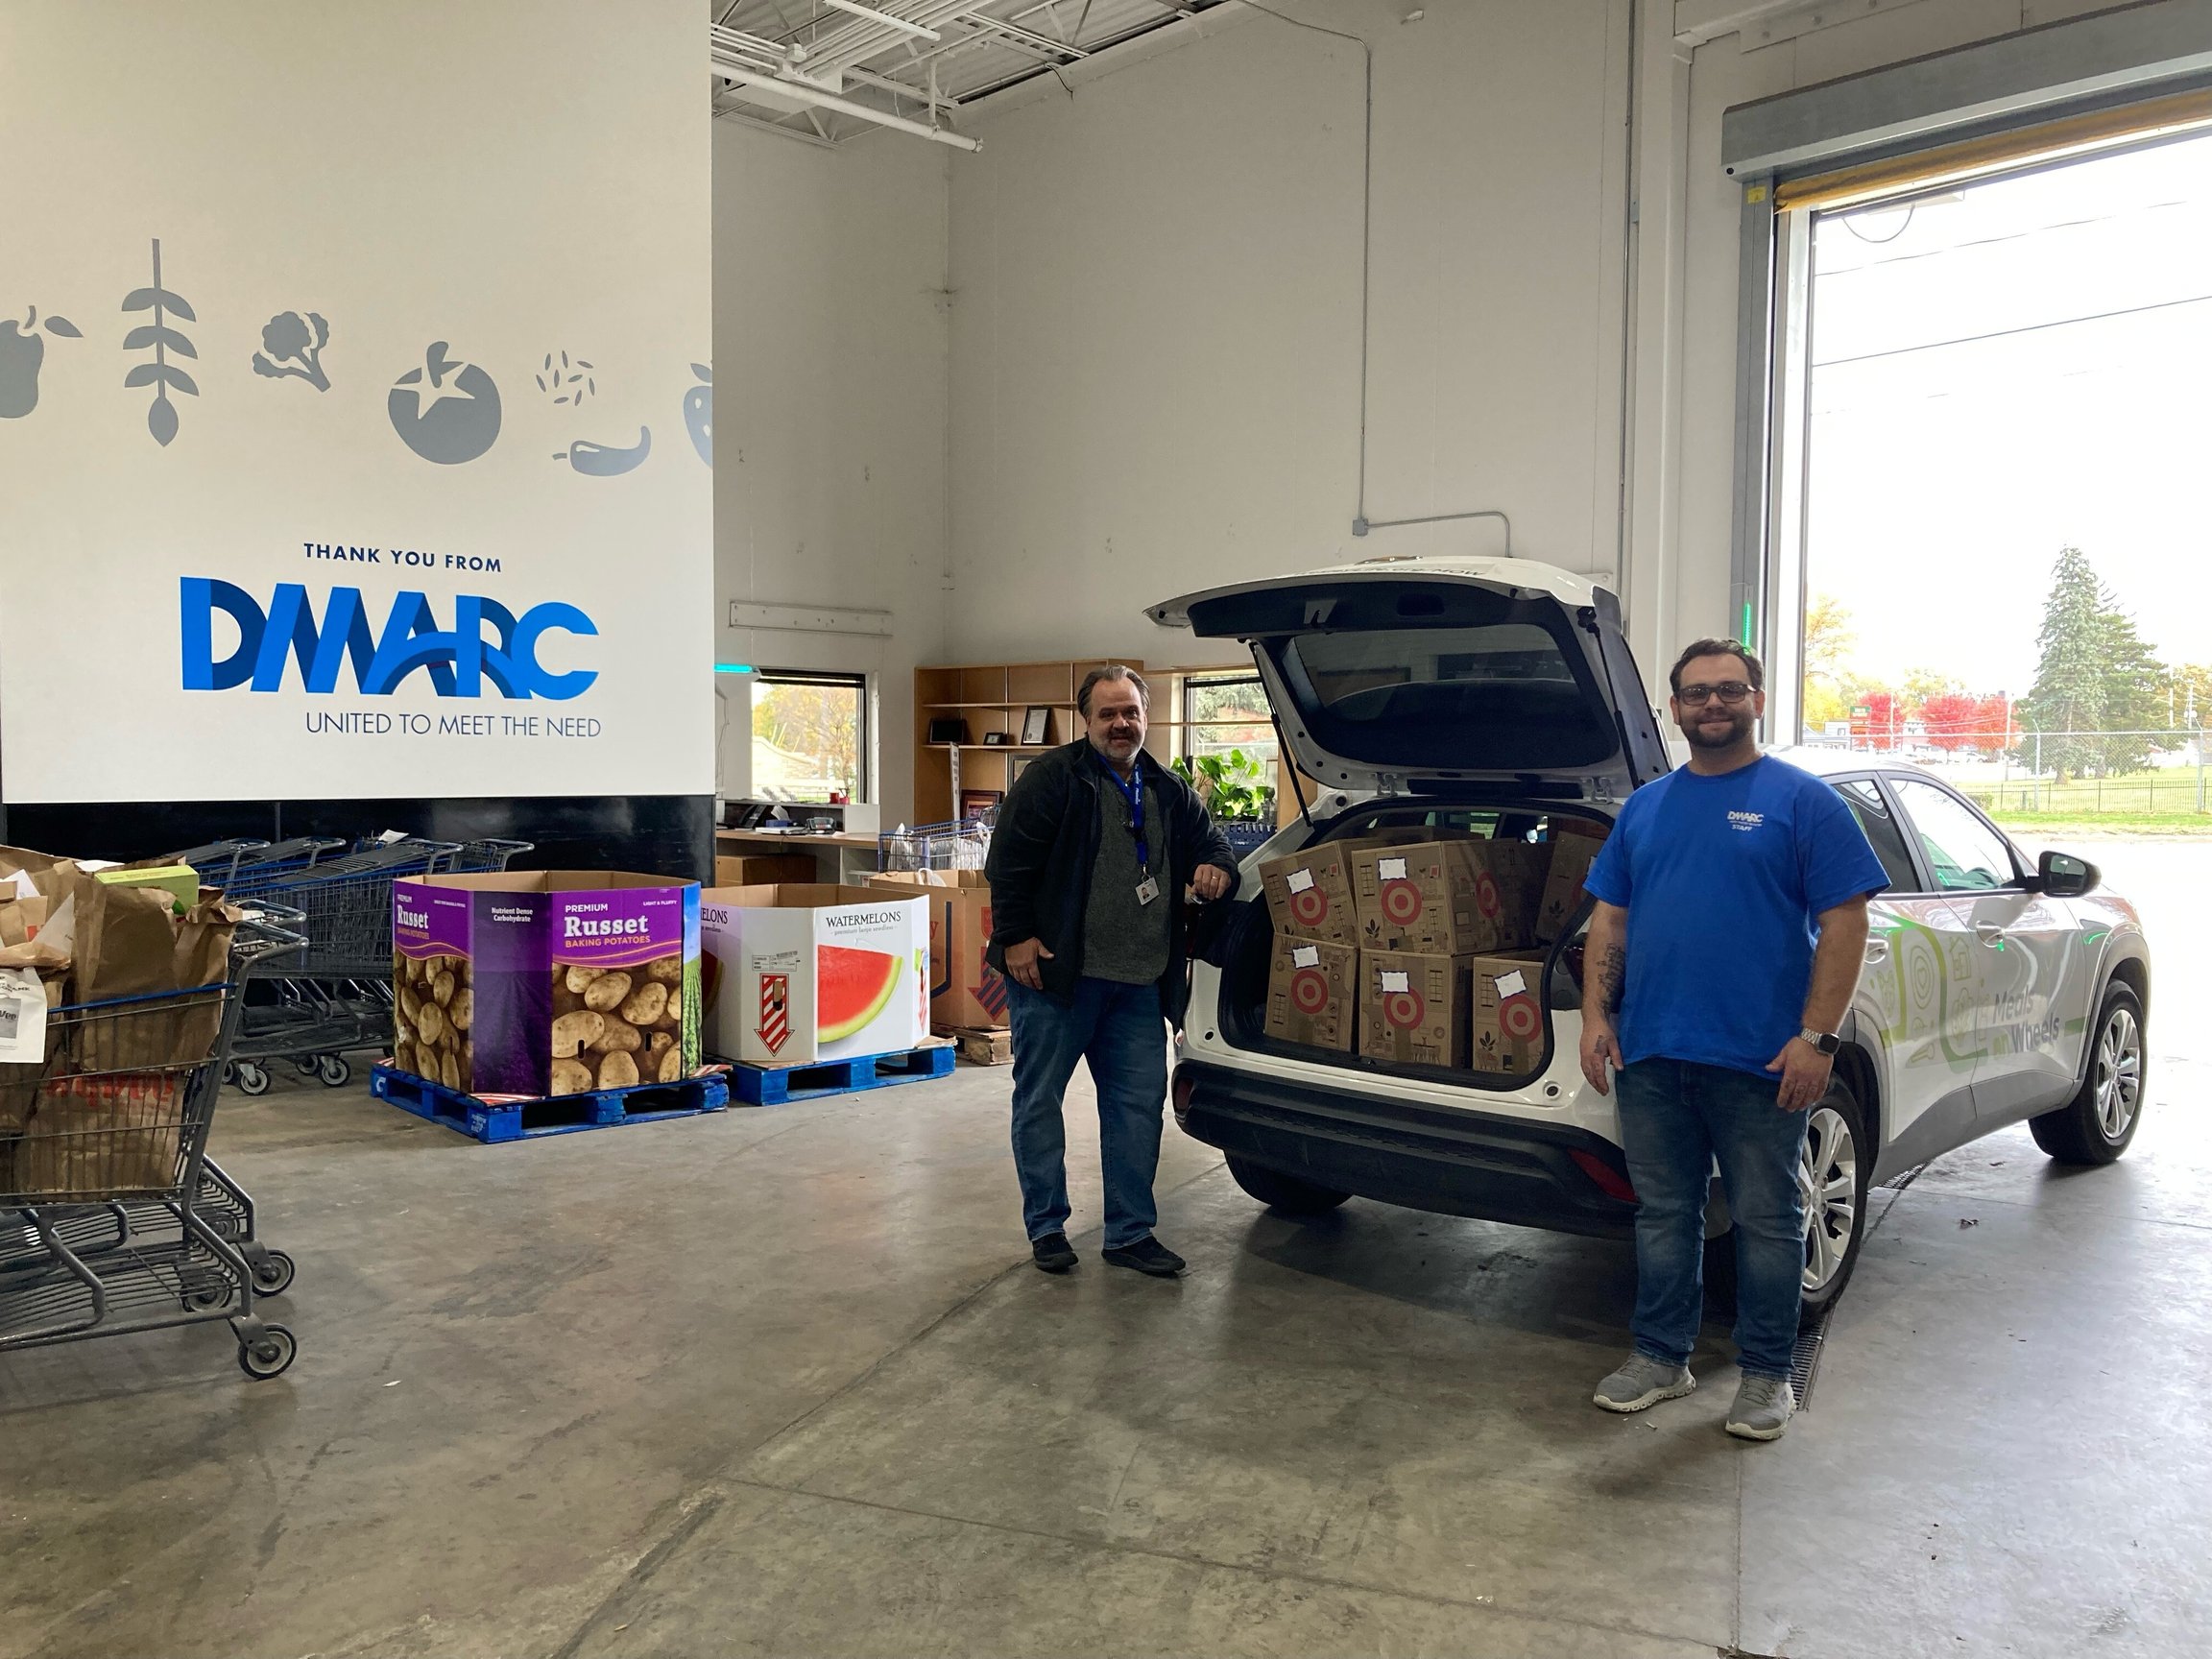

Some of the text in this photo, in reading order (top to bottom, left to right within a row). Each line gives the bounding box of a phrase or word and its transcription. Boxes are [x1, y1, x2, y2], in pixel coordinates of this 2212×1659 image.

[303, 542, 502, 573] THANK YOU FROM
[180, 576, 600, 701] DMARC
[306, 711, 602, 737] UNITED TO MEET THE NEED
[1727, 810, 1765, 823] DMARC
[397, 904, 429, 929] Russet
[491, 906, 516, 915] Nutrient
[493, 914, 532, 924] Carbohydrate
[565, 902, 609, 913] PREMIUM
[825, 910, 902, 928] WATERMELONS
[564, 915, 650, 938] Russet
[565, 935, 651, 949] BAKING POTATOES
[1993, 984, 2034, 1024] Meals
[2010, 1011, 2060, 1054] Wheels
